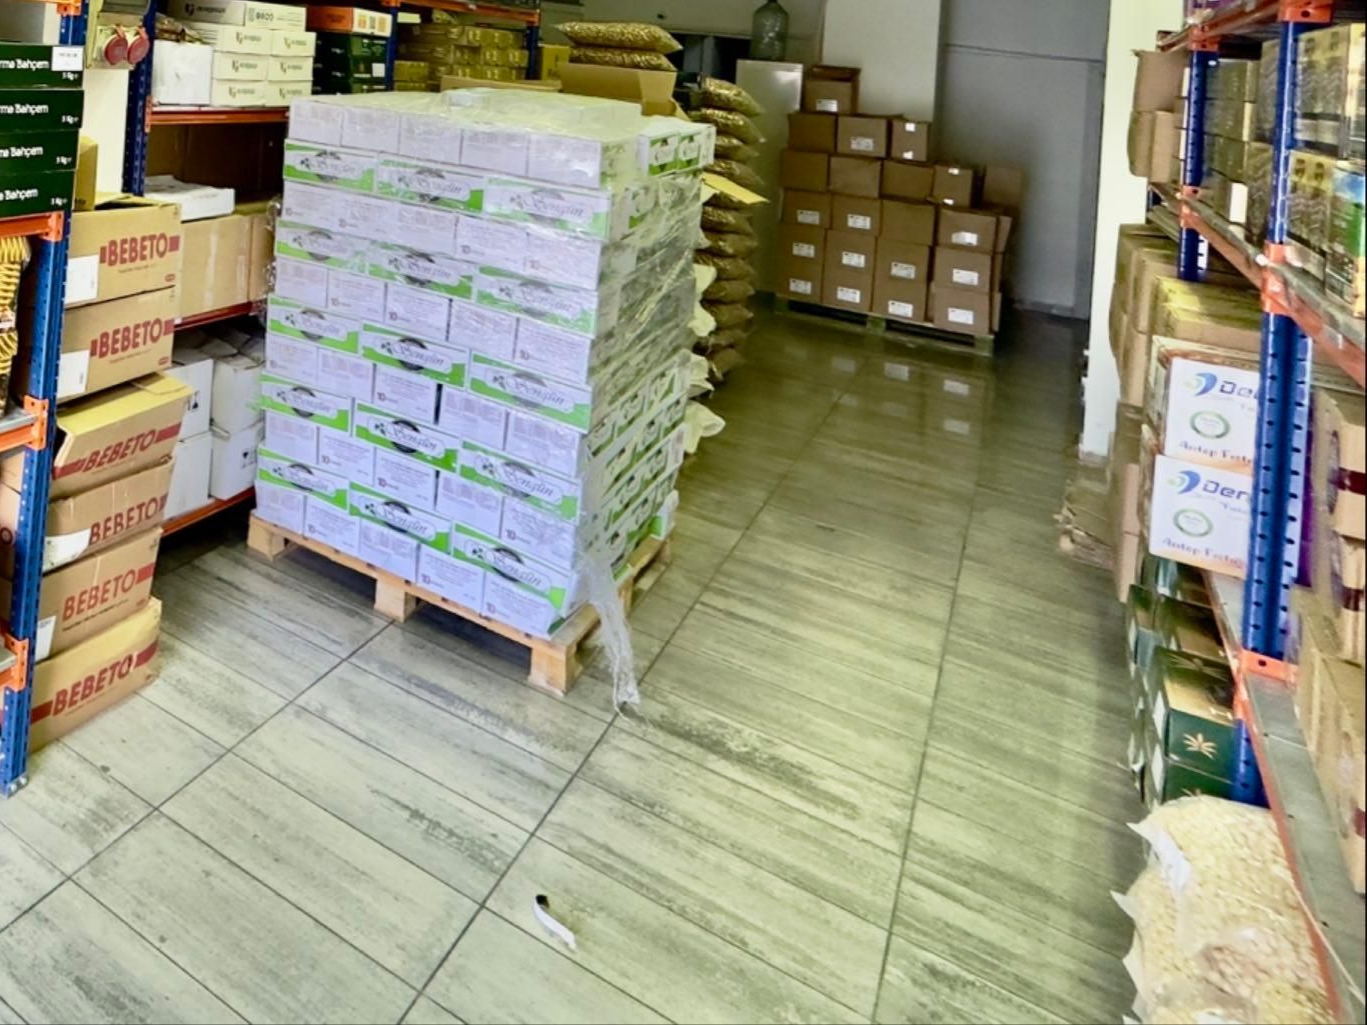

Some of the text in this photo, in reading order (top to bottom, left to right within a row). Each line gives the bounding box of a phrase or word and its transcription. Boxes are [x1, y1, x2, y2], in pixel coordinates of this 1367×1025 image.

[108, 233, 167, 267] BEBETO
[98, 318, 163, 359] BEBETO
[83, 429, 156, 472] BEBETO
[89, 496, 159, 546] BEBETO
[62, 569, 136, 622] BEBETO
[52, 653, 134, 717] BEBETO
